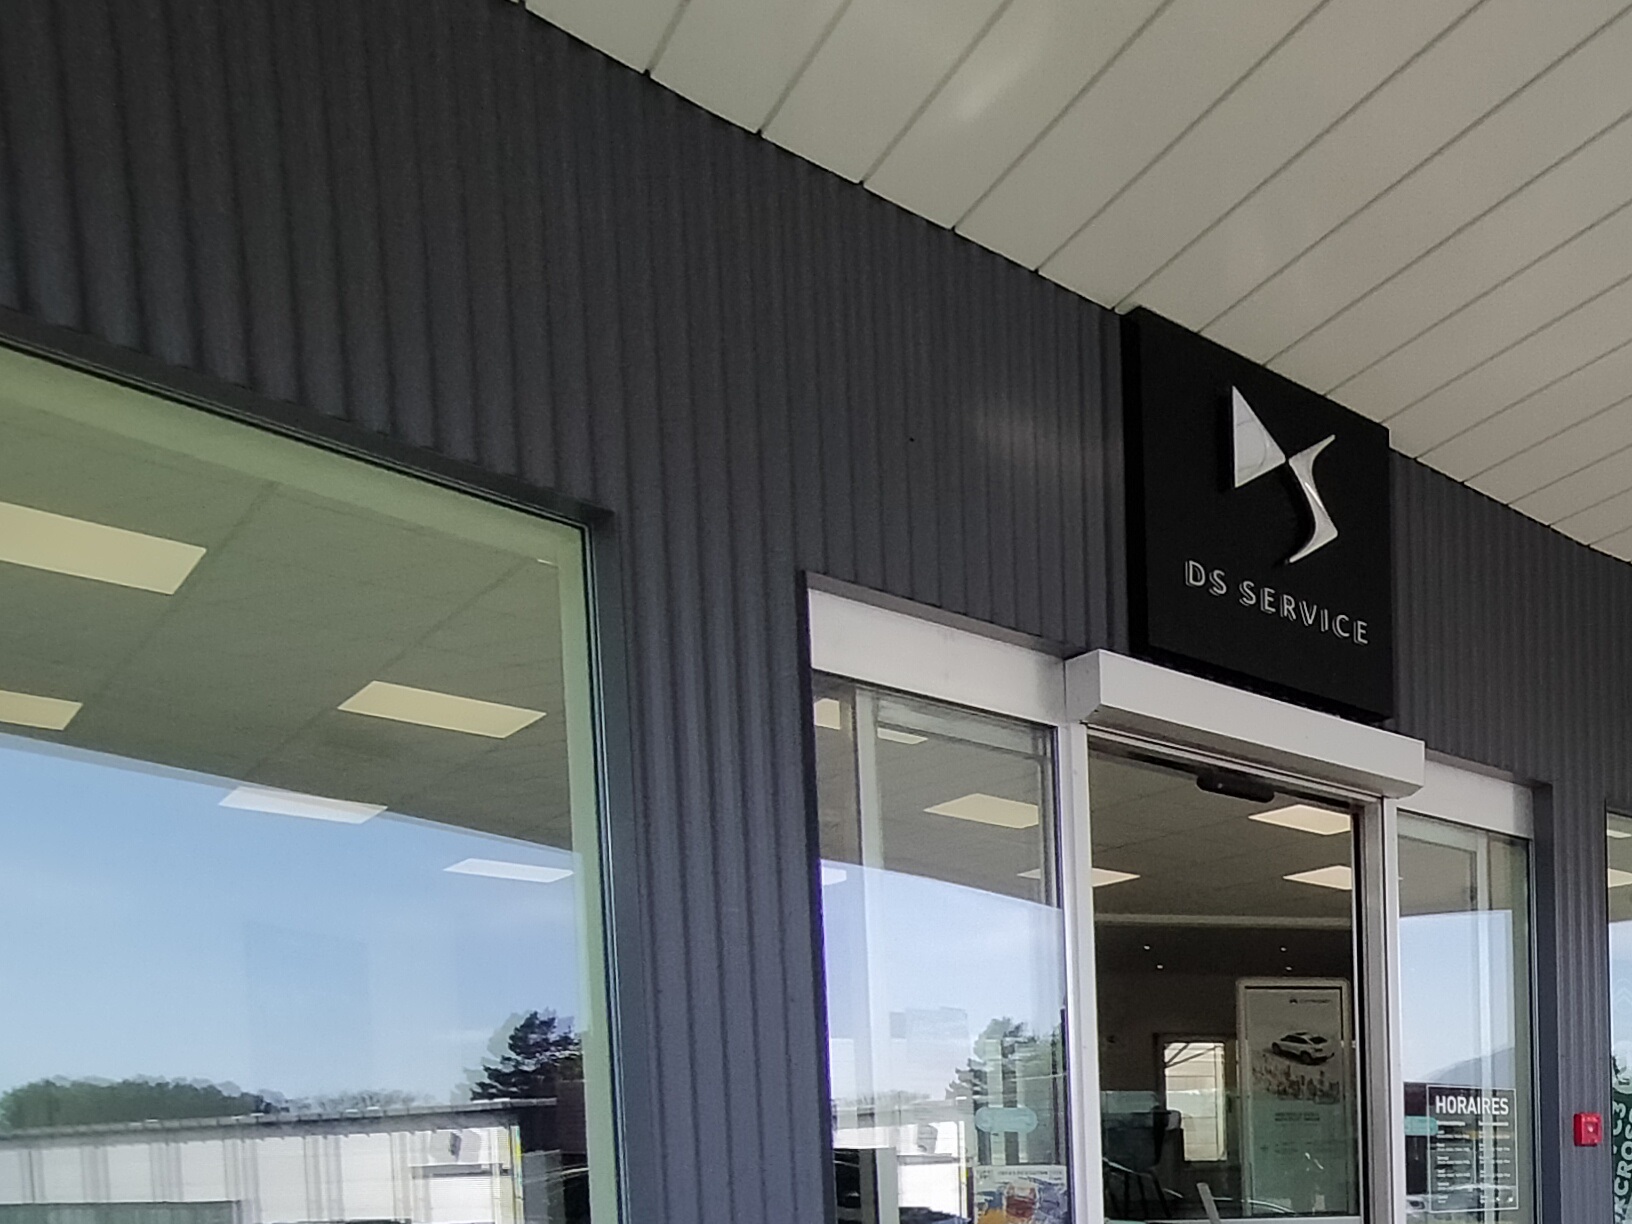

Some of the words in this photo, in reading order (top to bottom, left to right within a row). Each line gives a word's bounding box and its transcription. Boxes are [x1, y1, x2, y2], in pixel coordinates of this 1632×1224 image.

[1185, 560, 1228, 596] DS
[1239, 580, 1369, 645] SERVICE
[1435, 1095, 1509, 1116] HORAIRES
